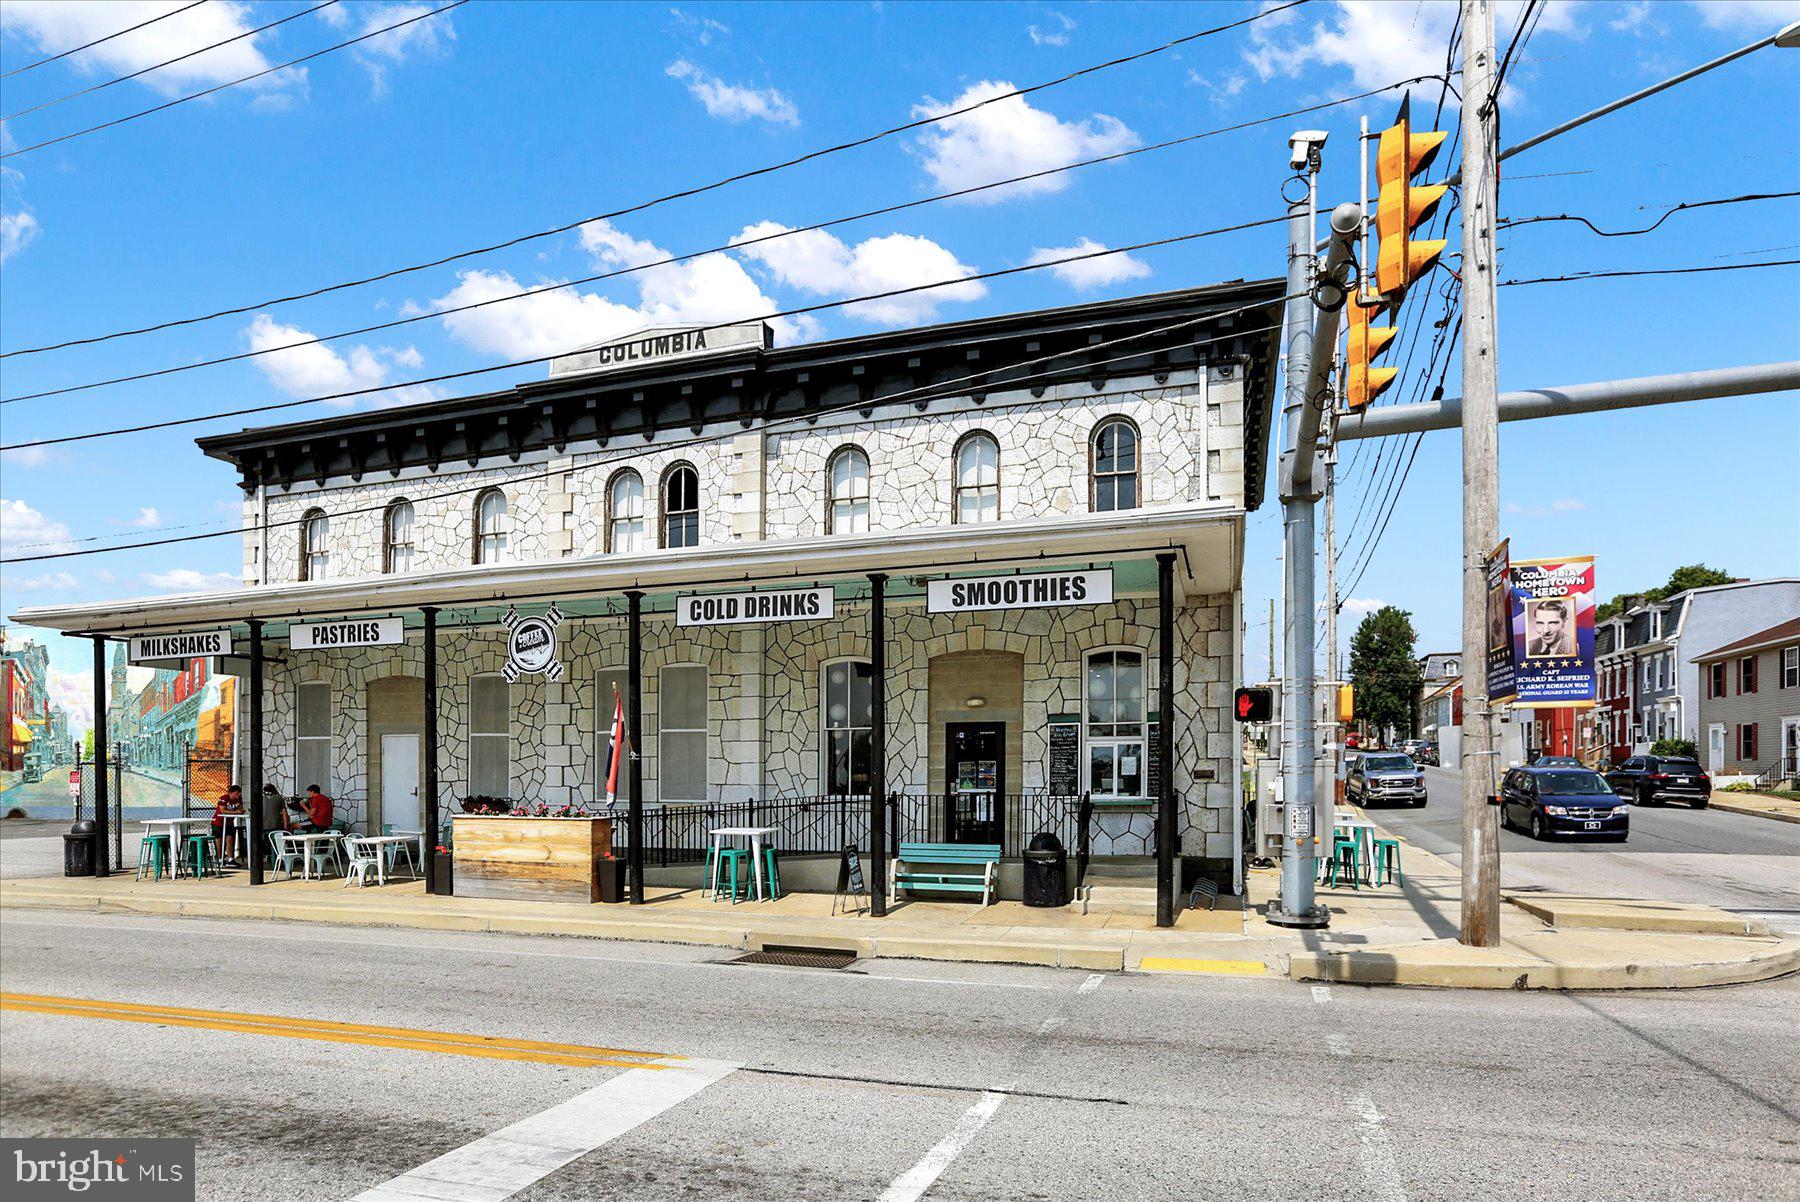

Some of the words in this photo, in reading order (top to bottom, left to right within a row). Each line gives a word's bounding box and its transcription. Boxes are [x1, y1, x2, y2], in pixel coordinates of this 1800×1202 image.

[599, 330, 707, 364] COLUMBIA
[1515, 576, 1585, 589] HOMETOWN
[1520, 569, 1577, 580] COLUMBIA
[951, 575, 1087, 607] SMOOTHIES
[1532, 586, 1569, 597] HERO
[690, 597, 739, 622] COLD
[744, 592, 820, 619] DRINKS
[312, 622, 380, 645] PASTRIES
[517, 627, 544, 644] COFFEE
[140, 634, 221, 658] MILKSHAKES
